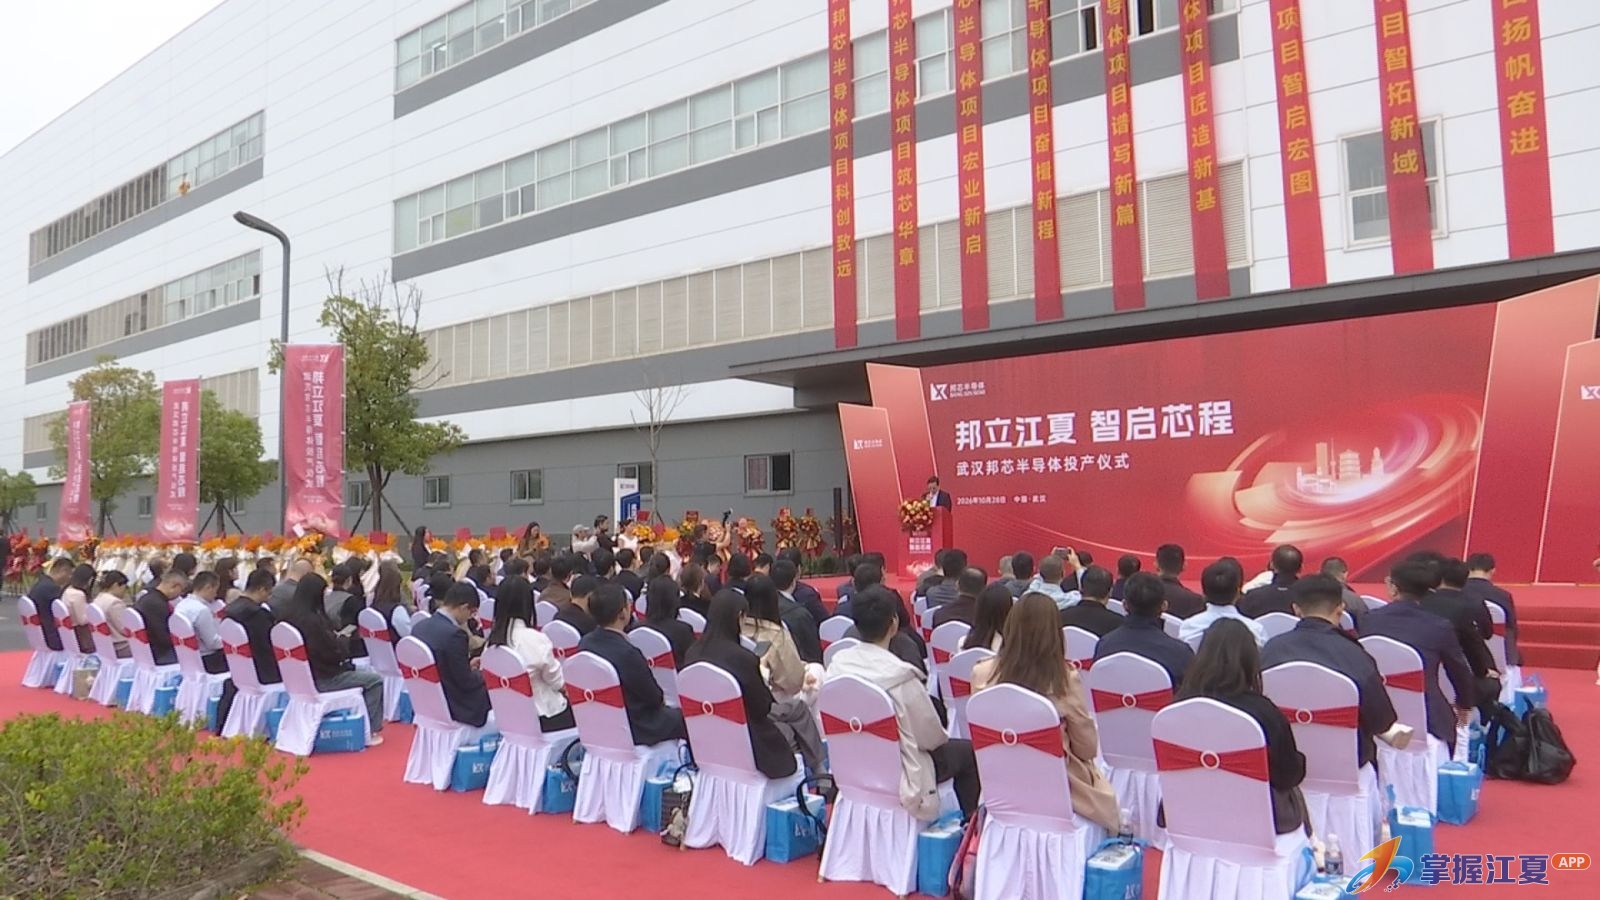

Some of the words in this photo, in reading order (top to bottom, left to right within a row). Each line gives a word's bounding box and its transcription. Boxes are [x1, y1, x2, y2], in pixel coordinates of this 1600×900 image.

[832, 0, 852, 278] 邦芯半导体项目科创致远
[1277, 7, 1313, 196] 项目智启宏图
[1380, 0, 1419, 175] 目智拓新域
[955, 411, 1076, 451] 邦立江夏
[1090, 400, 1234, 442] 智启芯程
[956, 453, 1130, 477] 武汉邦芯半导体投产仪式
